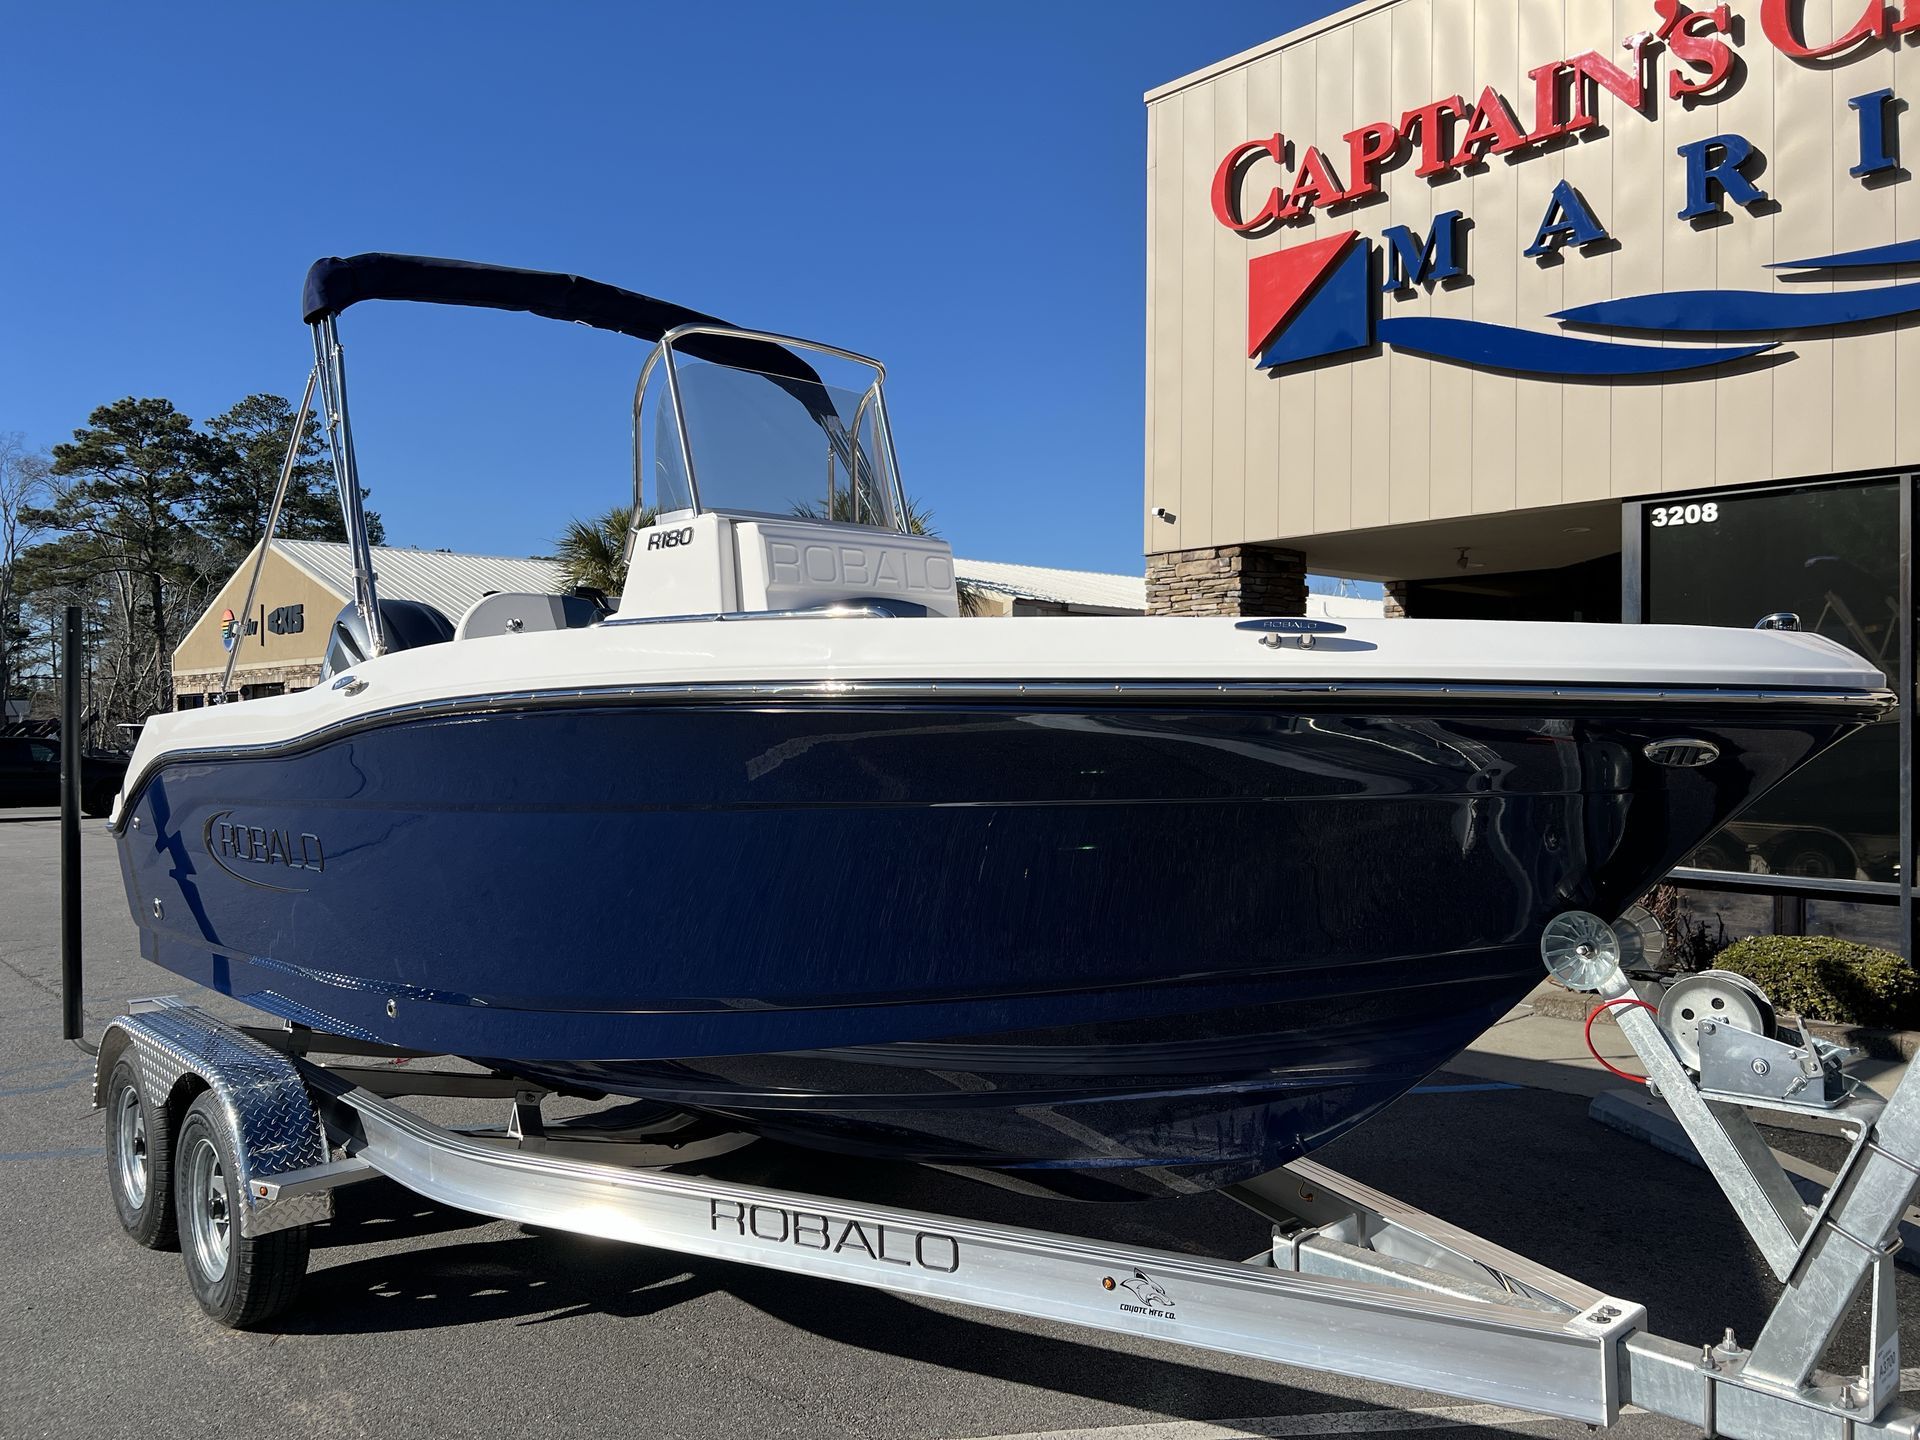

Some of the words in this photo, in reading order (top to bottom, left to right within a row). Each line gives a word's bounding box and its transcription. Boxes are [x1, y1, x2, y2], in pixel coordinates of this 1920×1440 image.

[1651, 502, 1719, 527] 3208
[647, 526, 694, 551] R180
[768, 541, 952, 592] ROBALO
[267, 603, 304, 635] AXIS
[1263, 621, 1317, 629] ROBALO
[219, 822, 324, 873] ROBALO
[710, 1197, 960, 1274] ROBALO
[1119, 1303, 1148, 1314] COYOTE
[1164, 1311, 1176, 1319] CO.
